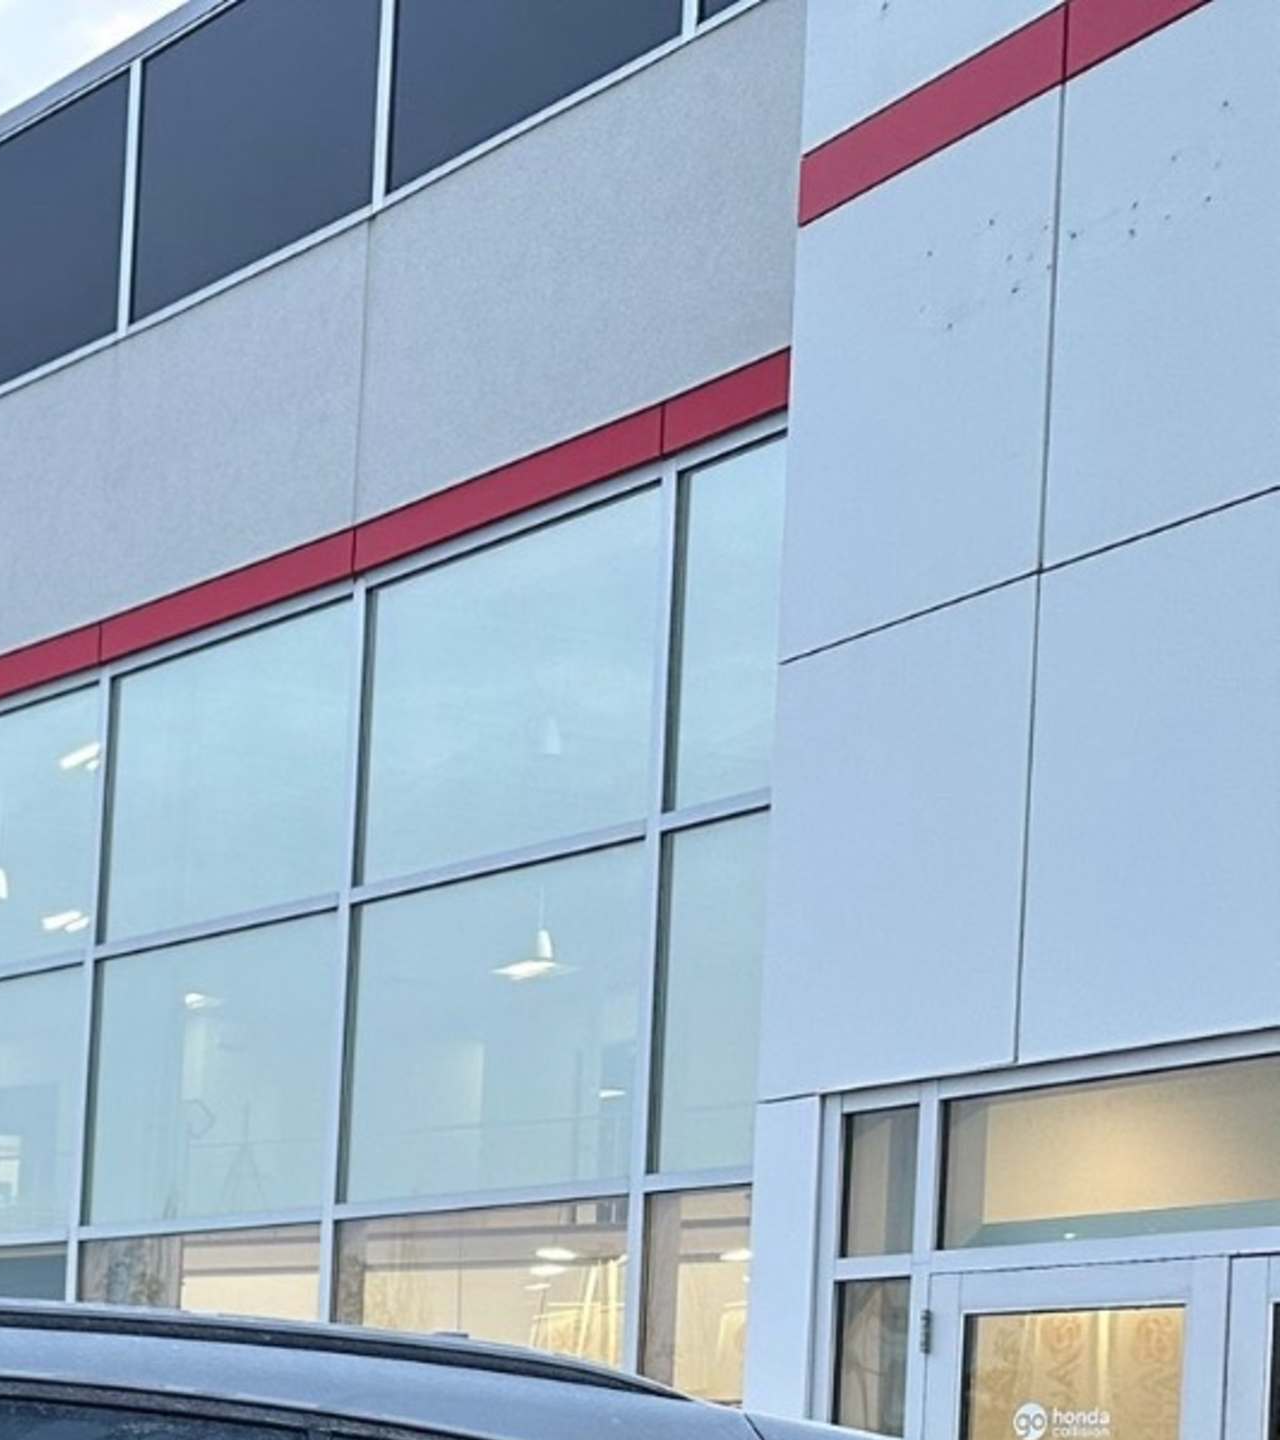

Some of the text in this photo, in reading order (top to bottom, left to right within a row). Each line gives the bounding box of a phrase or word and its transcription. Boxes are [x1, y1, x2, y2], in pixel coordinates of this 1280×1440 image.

[1014, 1409, 1047, 1440] go
[1052, 1407, 1111, 1425] honda
[1052, 1426, 1111, 1439] collision
